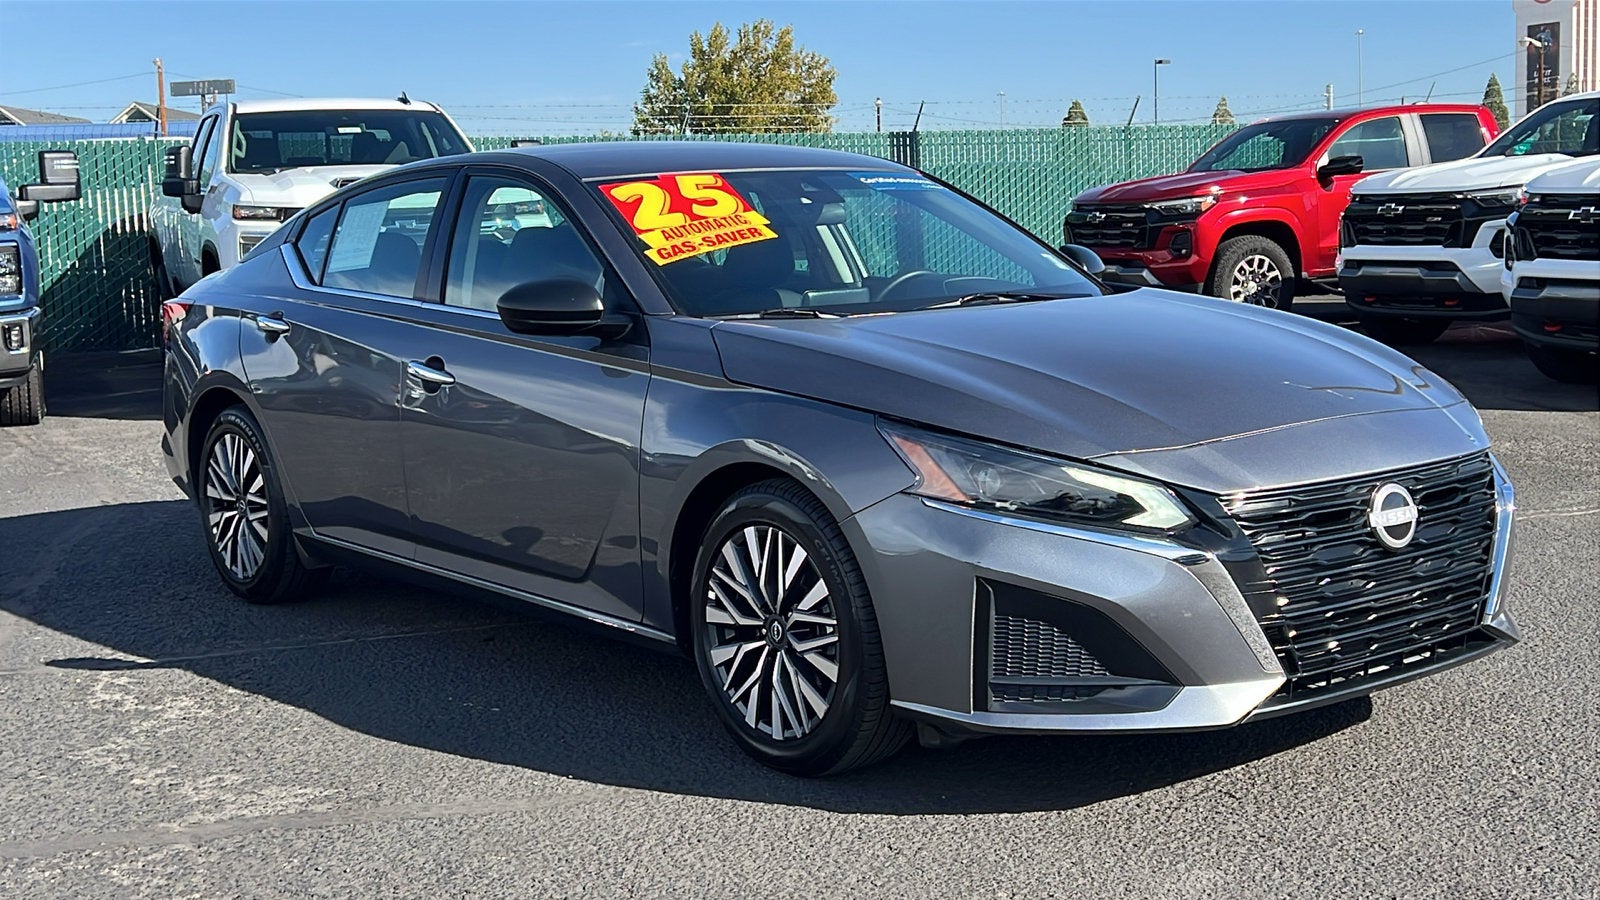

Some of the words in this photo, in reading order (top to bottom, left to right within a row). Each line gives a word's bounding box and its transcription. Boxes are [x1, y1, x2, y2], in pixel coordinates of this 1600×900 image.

[610, 175, 743, 231] 25
[661, 214, 749, 242] AUTOMATIC
[656, 227, 763, 260] GAS-SAVER
[1372, 507, 1417, 526] NISSAN
